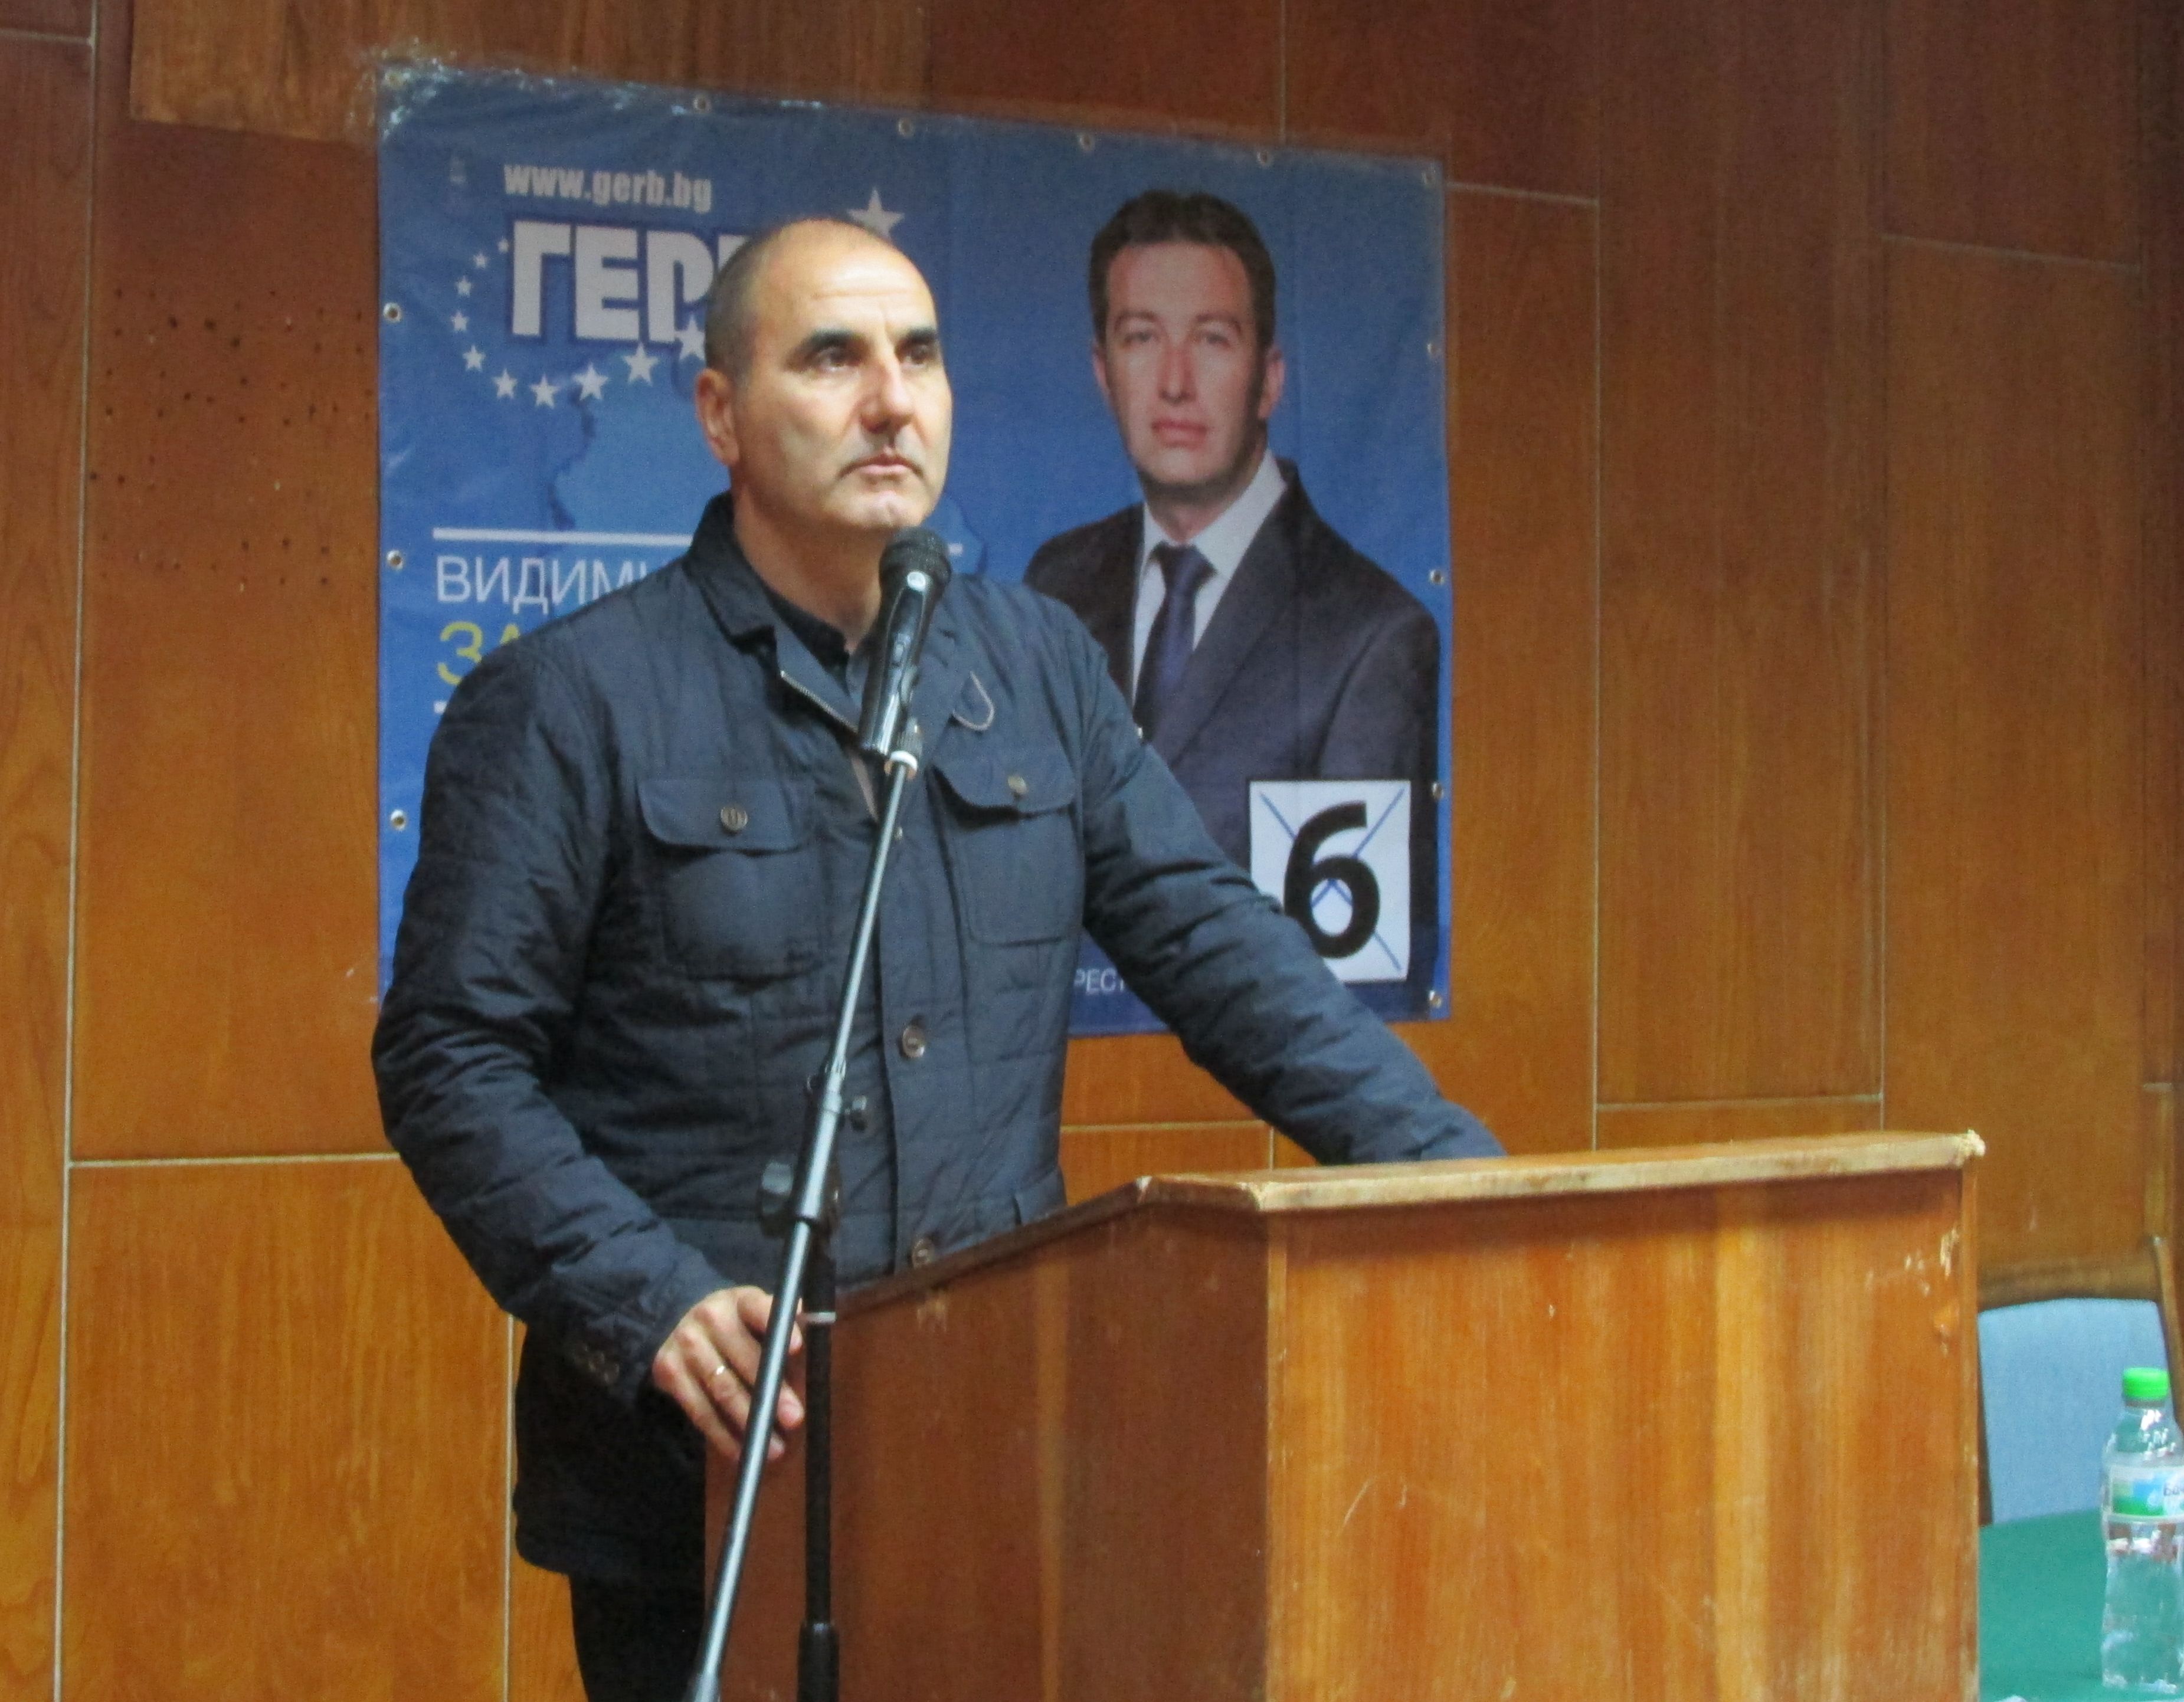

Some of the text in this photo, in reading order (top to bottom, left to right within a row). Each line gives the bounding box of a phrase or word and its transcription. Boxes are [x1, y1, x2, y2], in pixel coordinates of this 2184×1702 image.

[504, 165, 712, 214] www.gerb.bg
[512, 221, 746, 342] ГЕР
[437, 555, 647, 614] ВИДИМ
[1283, 801, 1380, 959] 6
